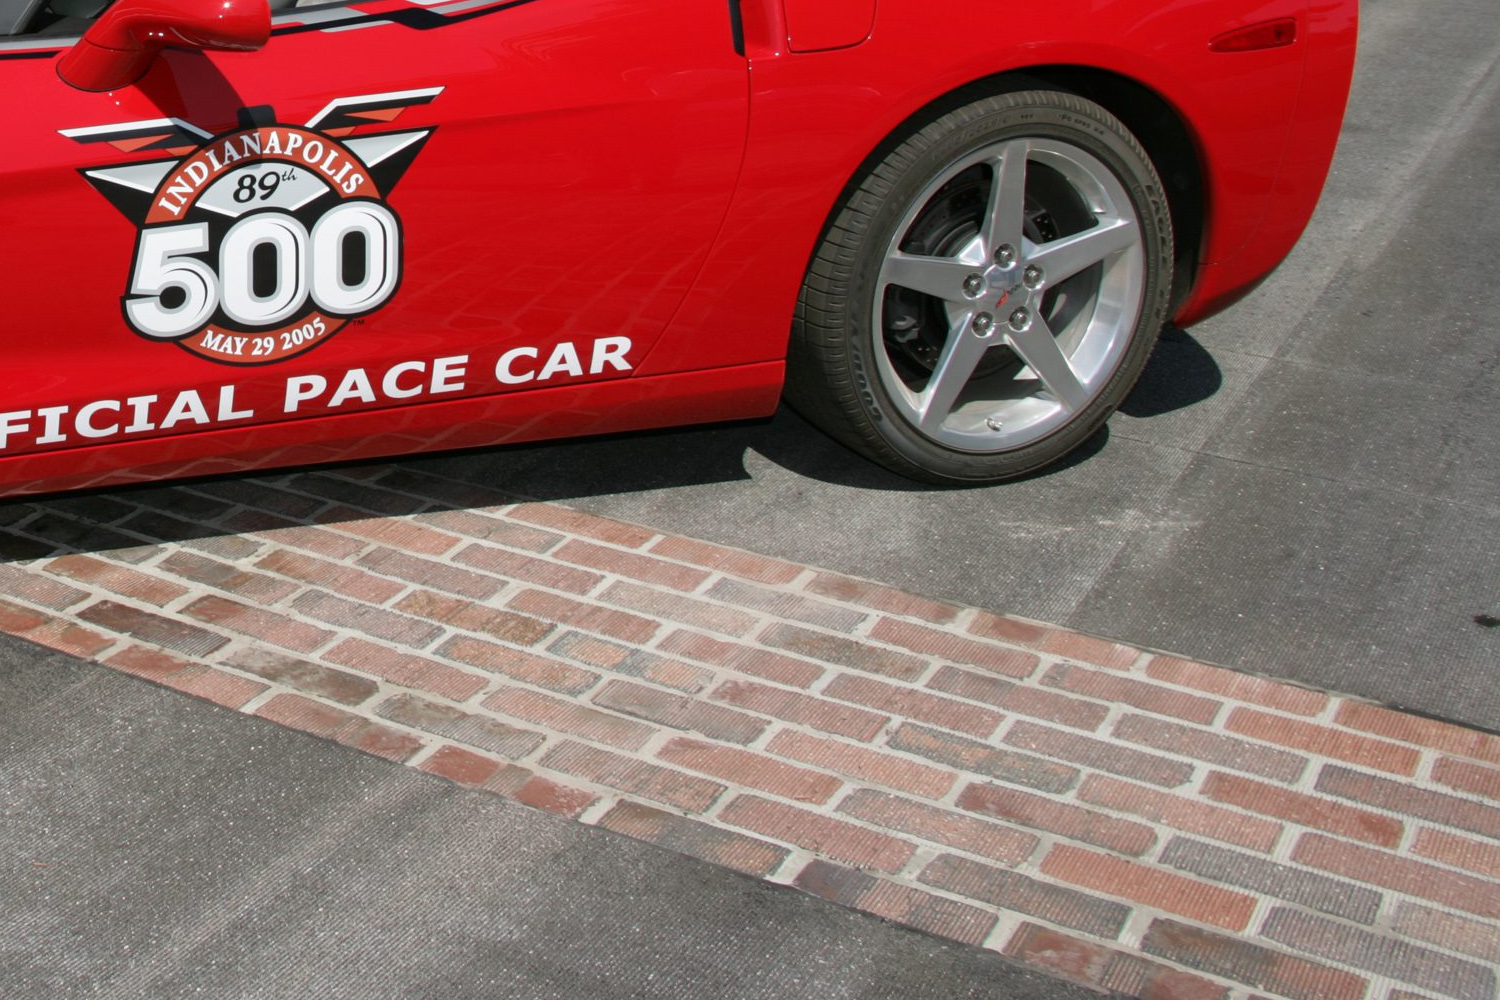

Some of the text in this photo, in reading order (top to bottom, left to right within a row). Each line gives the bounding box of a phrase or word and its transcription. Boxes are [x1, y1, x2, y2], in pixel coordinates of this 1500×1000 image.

[158, 130, 365, 216] INDIANAPOLIS
[232, 168, 298, 204] 89th
[125, 200, 399, 338] 500
[200, 317, 326, 356] MAY 29 2005
[283, 354, 469, 413] PACE
[494, 336, 633, 384] CAR
